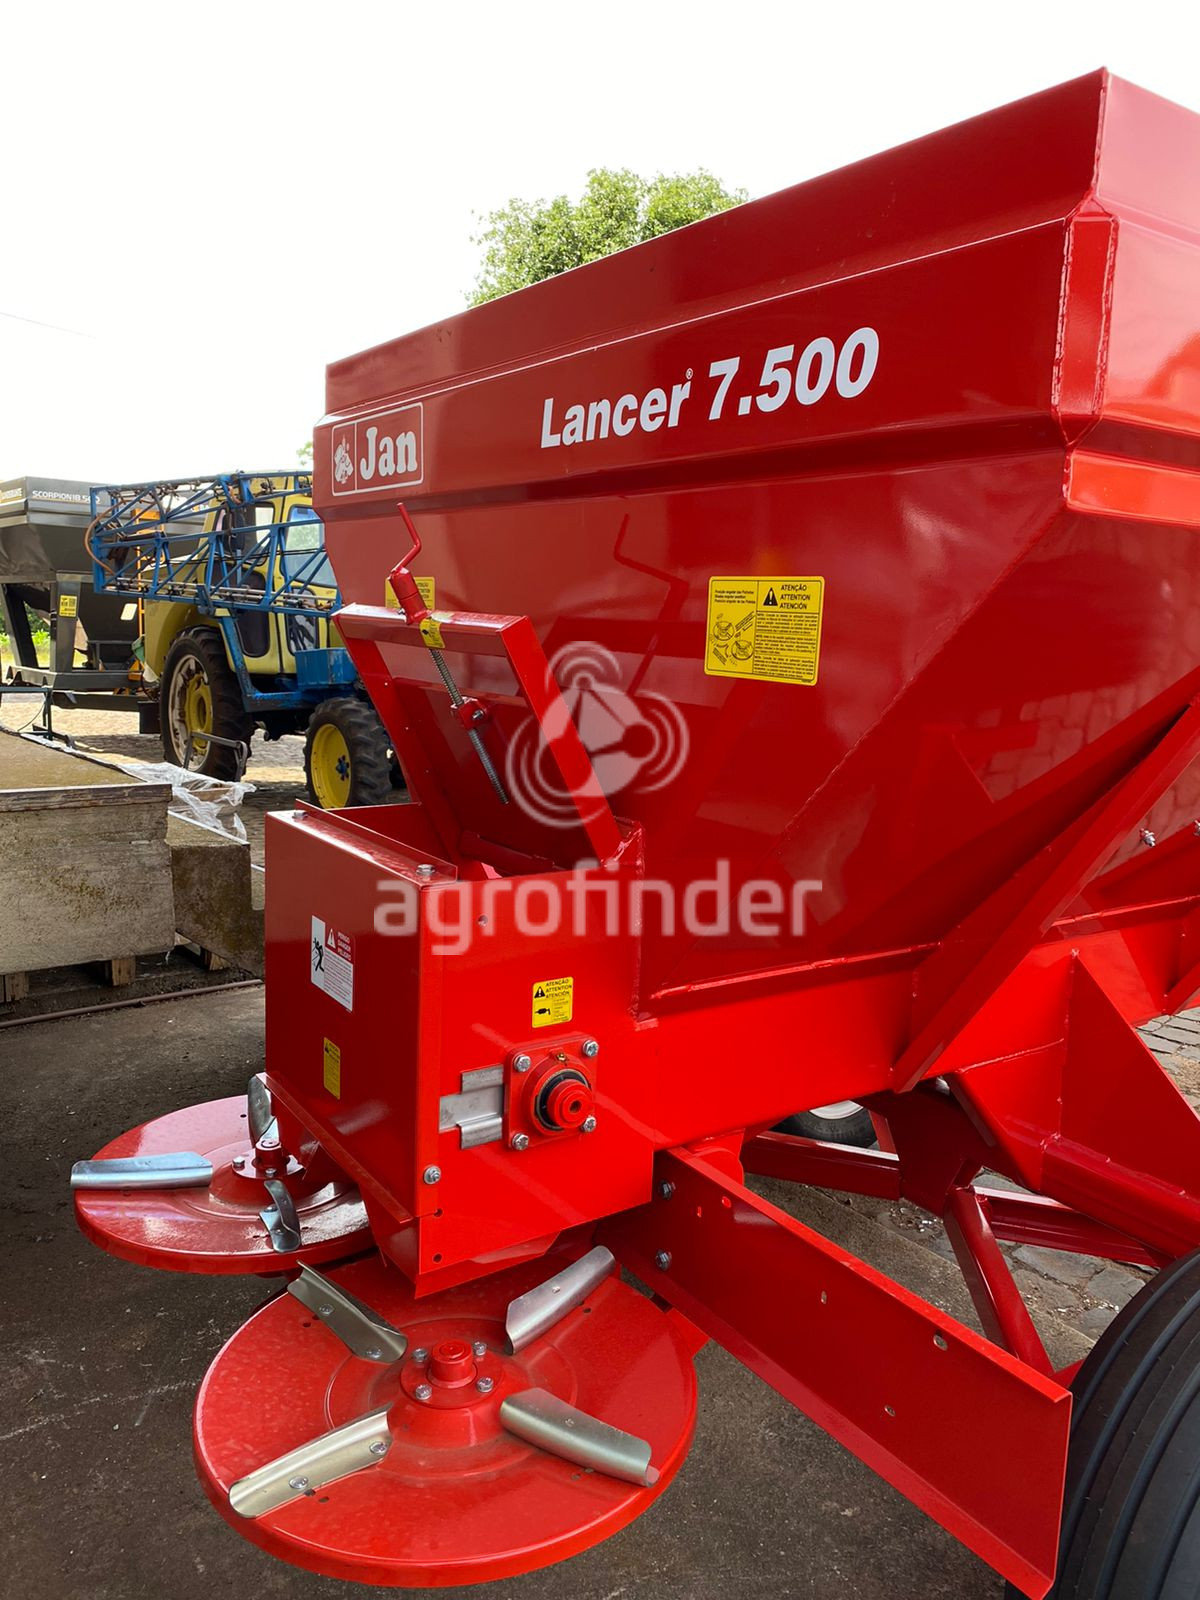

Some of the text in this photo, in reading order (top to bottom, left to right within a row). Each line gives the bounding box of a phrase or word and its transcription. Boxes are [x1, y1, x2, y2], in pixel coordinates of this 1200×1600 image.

[708, 326, 880, 421] 7.500
[360, 426, 418, 481] Jan
[781, 583, 807, 592] ATENÇÃO
[780, 593, 811, 601] ATTENTION
[546, 984, 572, 993] ATTENTION
